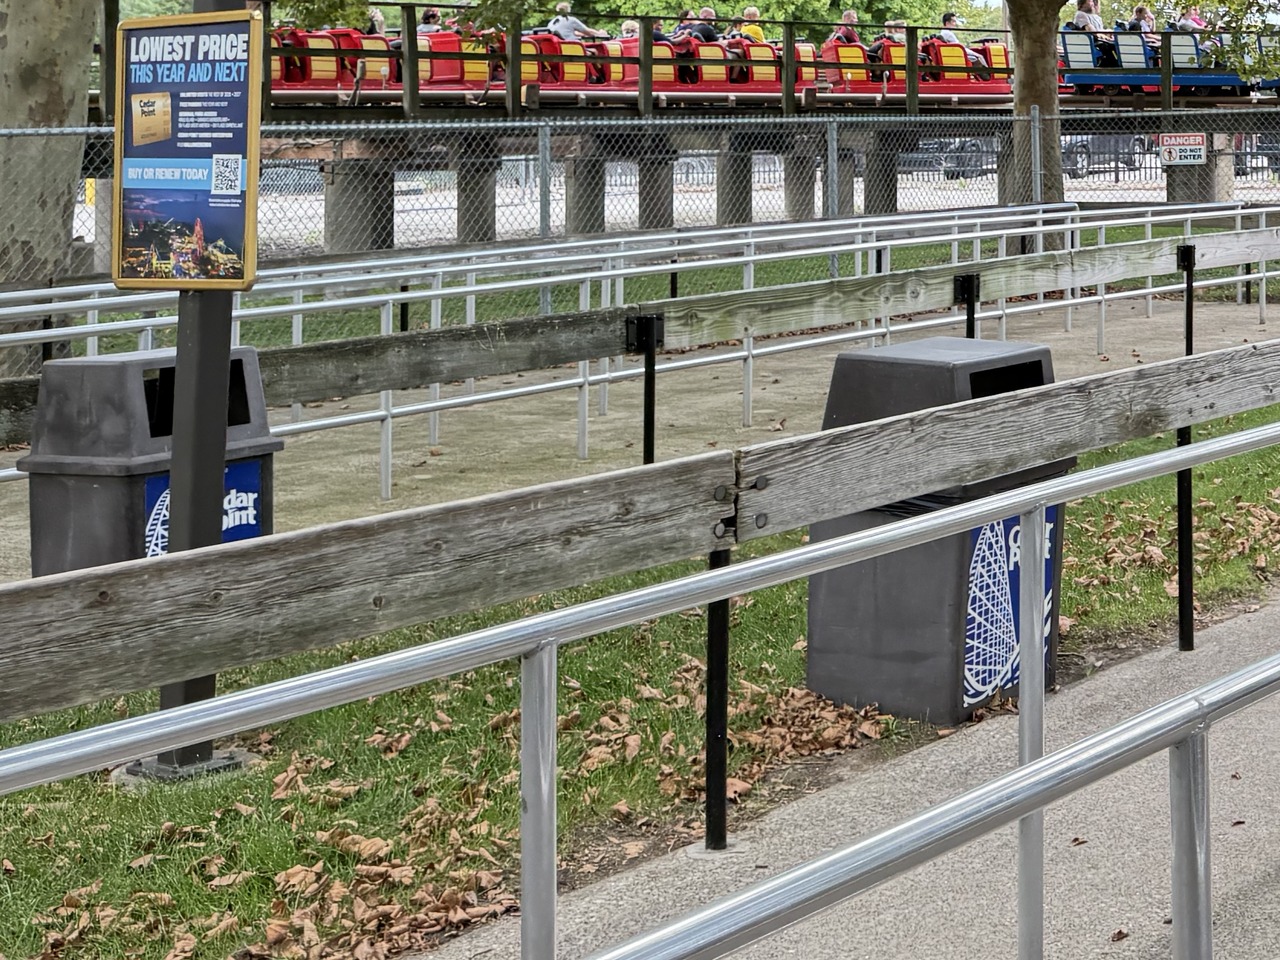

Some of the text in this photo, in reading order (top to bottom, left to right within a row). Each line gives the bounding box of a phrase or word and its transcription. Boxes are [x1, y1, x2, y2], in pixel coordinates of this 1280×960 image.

[130, 33, 249, 62] LOWEST PRICE
[130, 62, 248, 83] THIS YEAR AND NEXT
[1163, 136, 1203, 145] DANGER
[128, 167, 209, 180] BUY OR RENEW TODAY
[223, 488, 258, 510] dar
